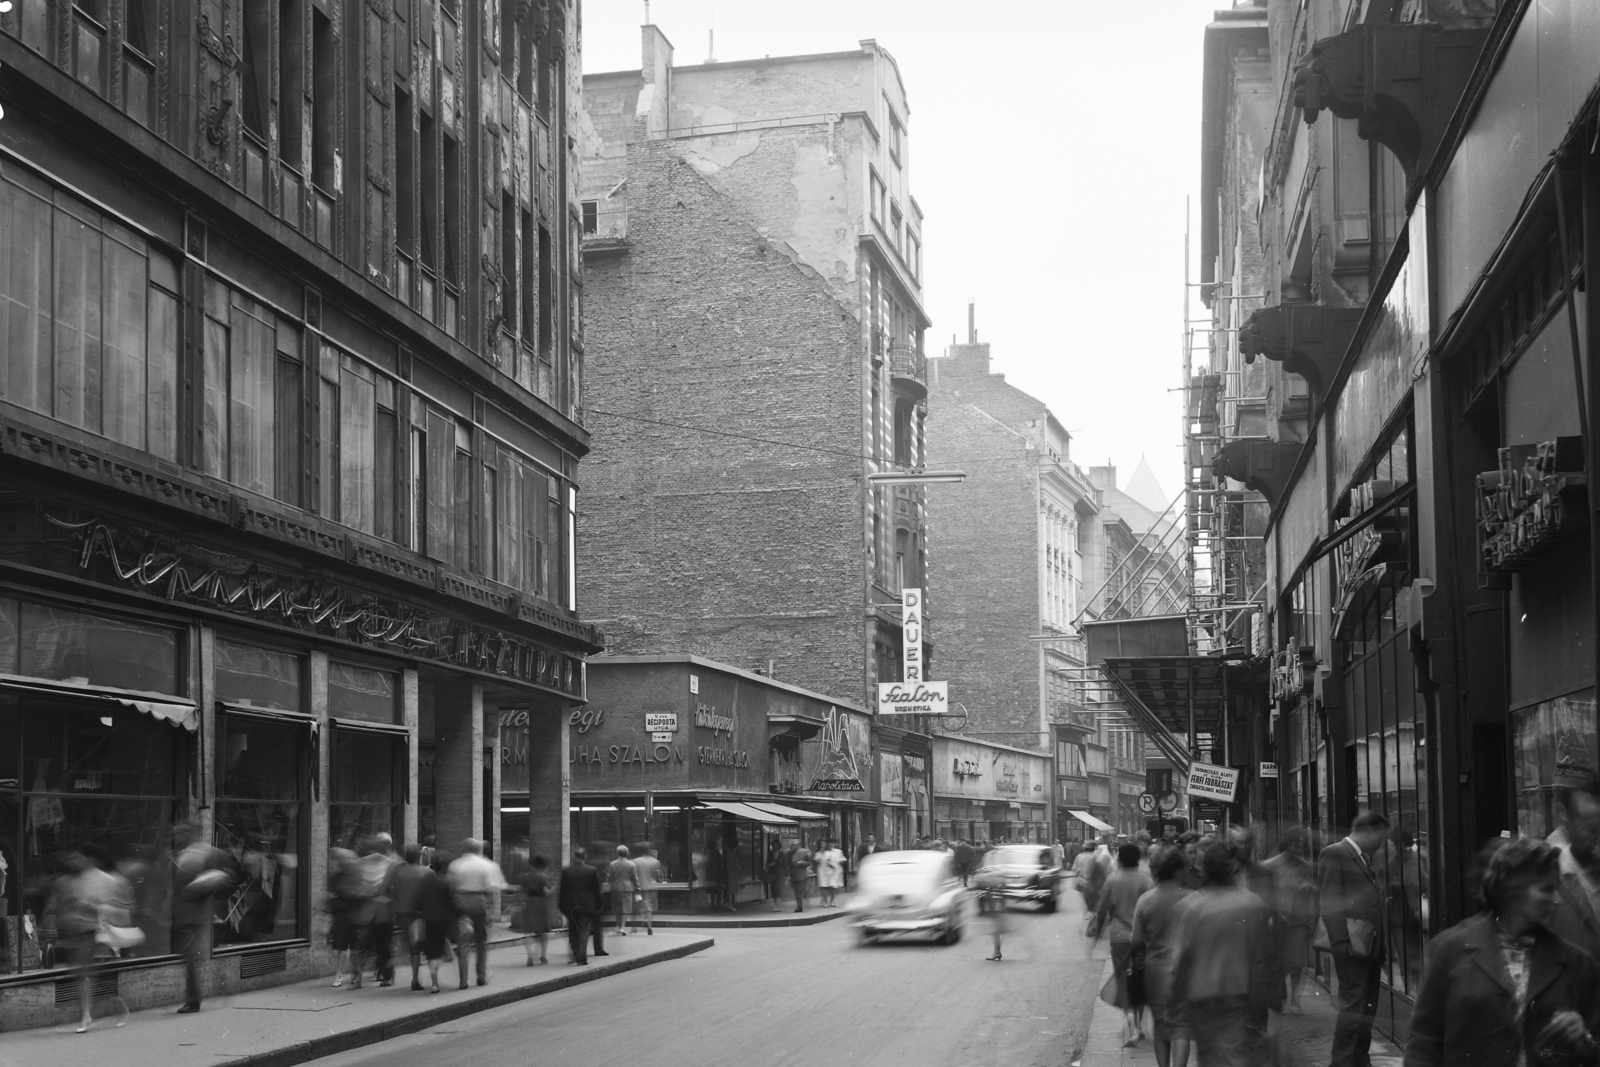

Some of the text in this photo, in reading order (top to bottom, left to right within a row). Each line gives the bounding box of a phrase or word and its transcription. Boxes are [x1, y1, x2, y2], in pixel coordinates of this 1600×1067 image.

[905, 592, 919, 680] DAUER
[609, 744, 684, 764] SZALON
[812, 780, 860, 790] Napoletana
[1190, 774, 1205, 785] FÉRFI
[1204, 777, 1234, 790] FODRÁSZAT
